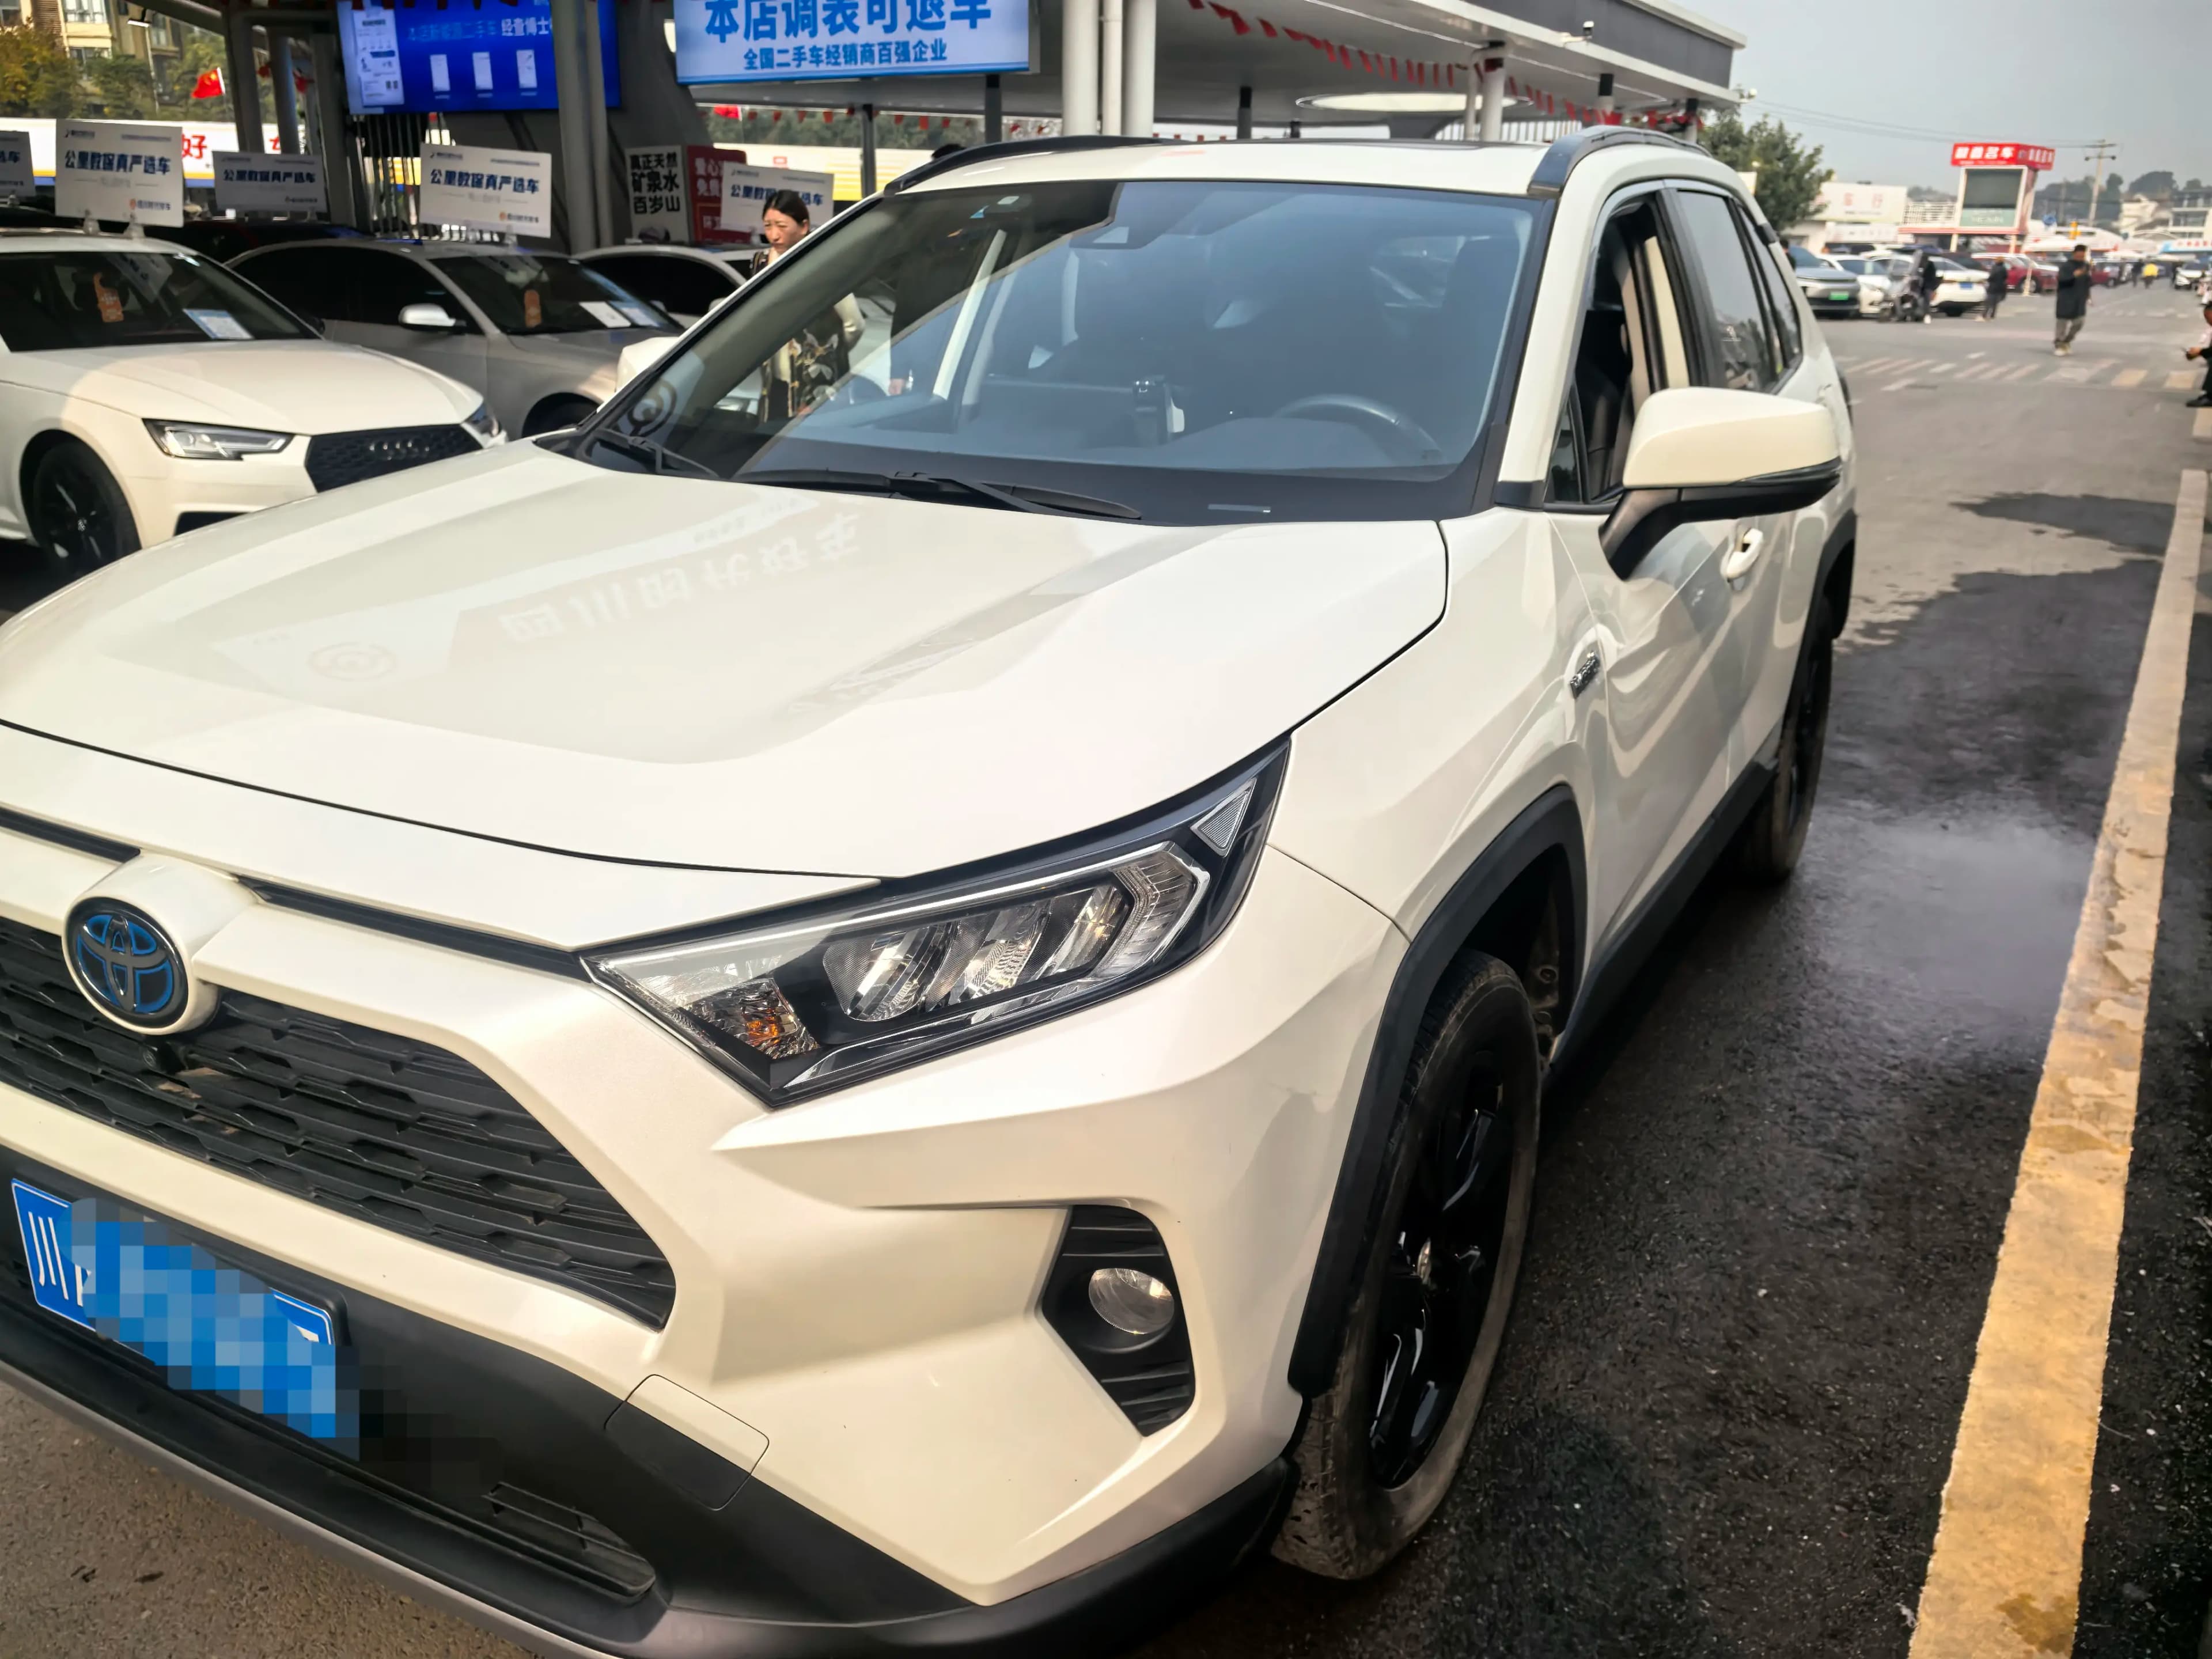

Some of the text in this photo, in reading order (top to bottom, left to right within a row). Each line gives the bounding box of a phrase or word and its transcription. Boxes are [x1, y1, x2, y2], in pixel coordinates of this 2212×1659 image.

[501, 17, 552, 36] 经查博士
[705, 0, 991, 43] 本店调表可退车
[744, 38, 948, 71] 全国二手车经销商百强企业
[634, 195, 680, 214] 百岁山
